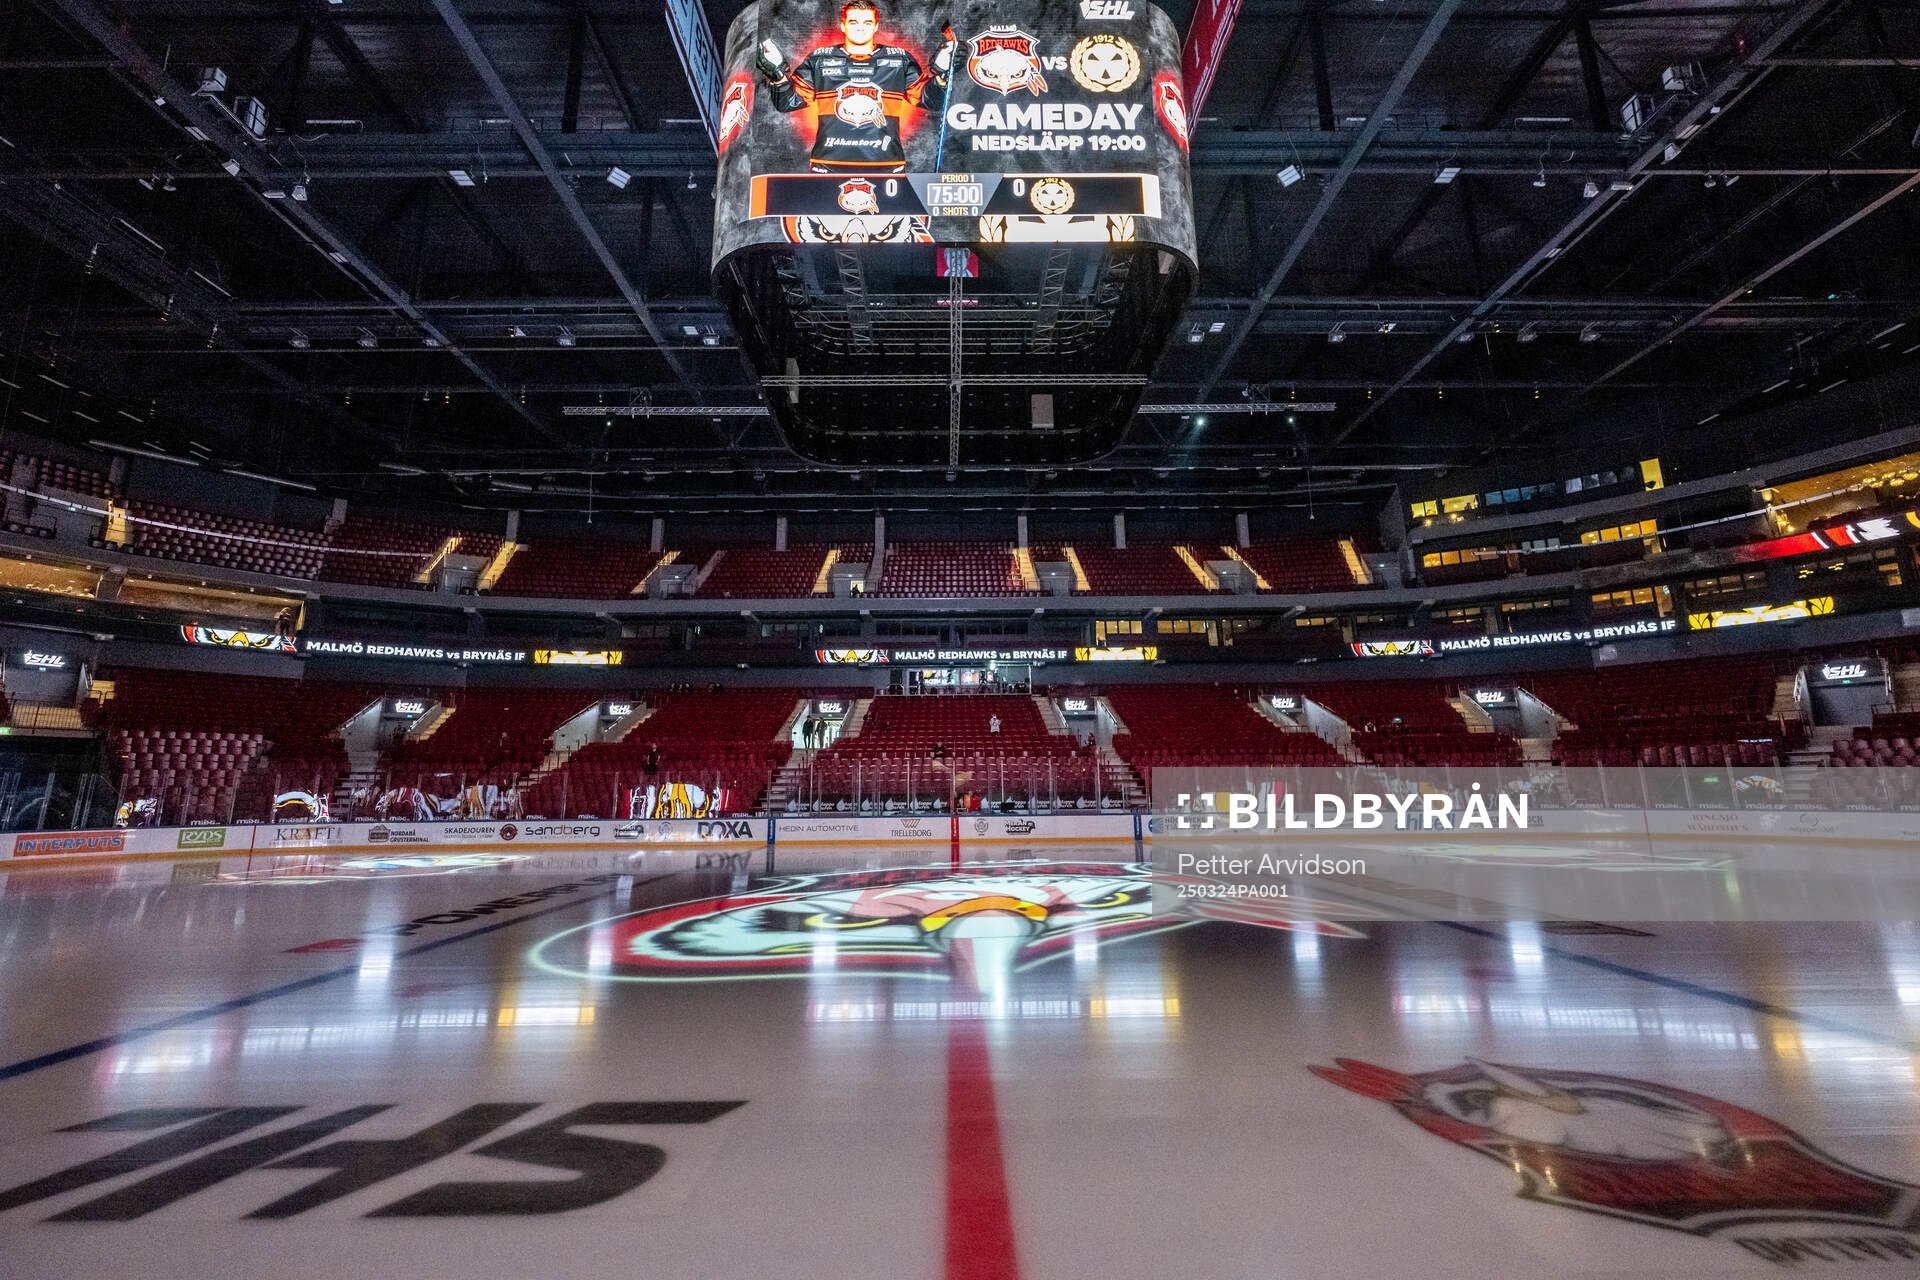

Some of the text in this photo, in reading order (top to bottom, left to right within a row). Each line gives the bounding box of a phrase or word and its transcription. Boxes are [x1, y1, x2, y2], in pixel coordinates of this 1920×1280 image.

[979, 38, 1029, 55] REDHAWKS
[1092, 35, 1114, 43] 1912
[946, 103, 1144, 131] GAMEDAY
[972, 131, 1147, 151] NEDSLÄPP 19:00
[941, 174, 975, 183] PERIOD 1
[886, 178, 898, 197] 0
[931, 186, 981, 204] 75:00
[1013, 178, 1025, 197] 0
[932, 207, 979, 217] 0 SHOTS 0
[1440, 619, 1677, 651] MALMÖ REDHAWKS vs BRYNÄS IF
[306, 641, 526, 661] MALMÖ REDHAWKS vs BRYNÄS IF
[895, 648, 1068, 660] MALMÖ REDHAWKS vs BRYNÄS IF
[181, 830, 223, 841] RYDS
[276, 827, 335, 841] KRAFT
[525, 825, 601, 836] sandberg
[697, 821, 753, 838] DOXA
[778, 825, 804, 833] HEDIN
[891, 829, 932, 837] TRELLEBORG
[16, 835, 122, 852] INTERPUTS
